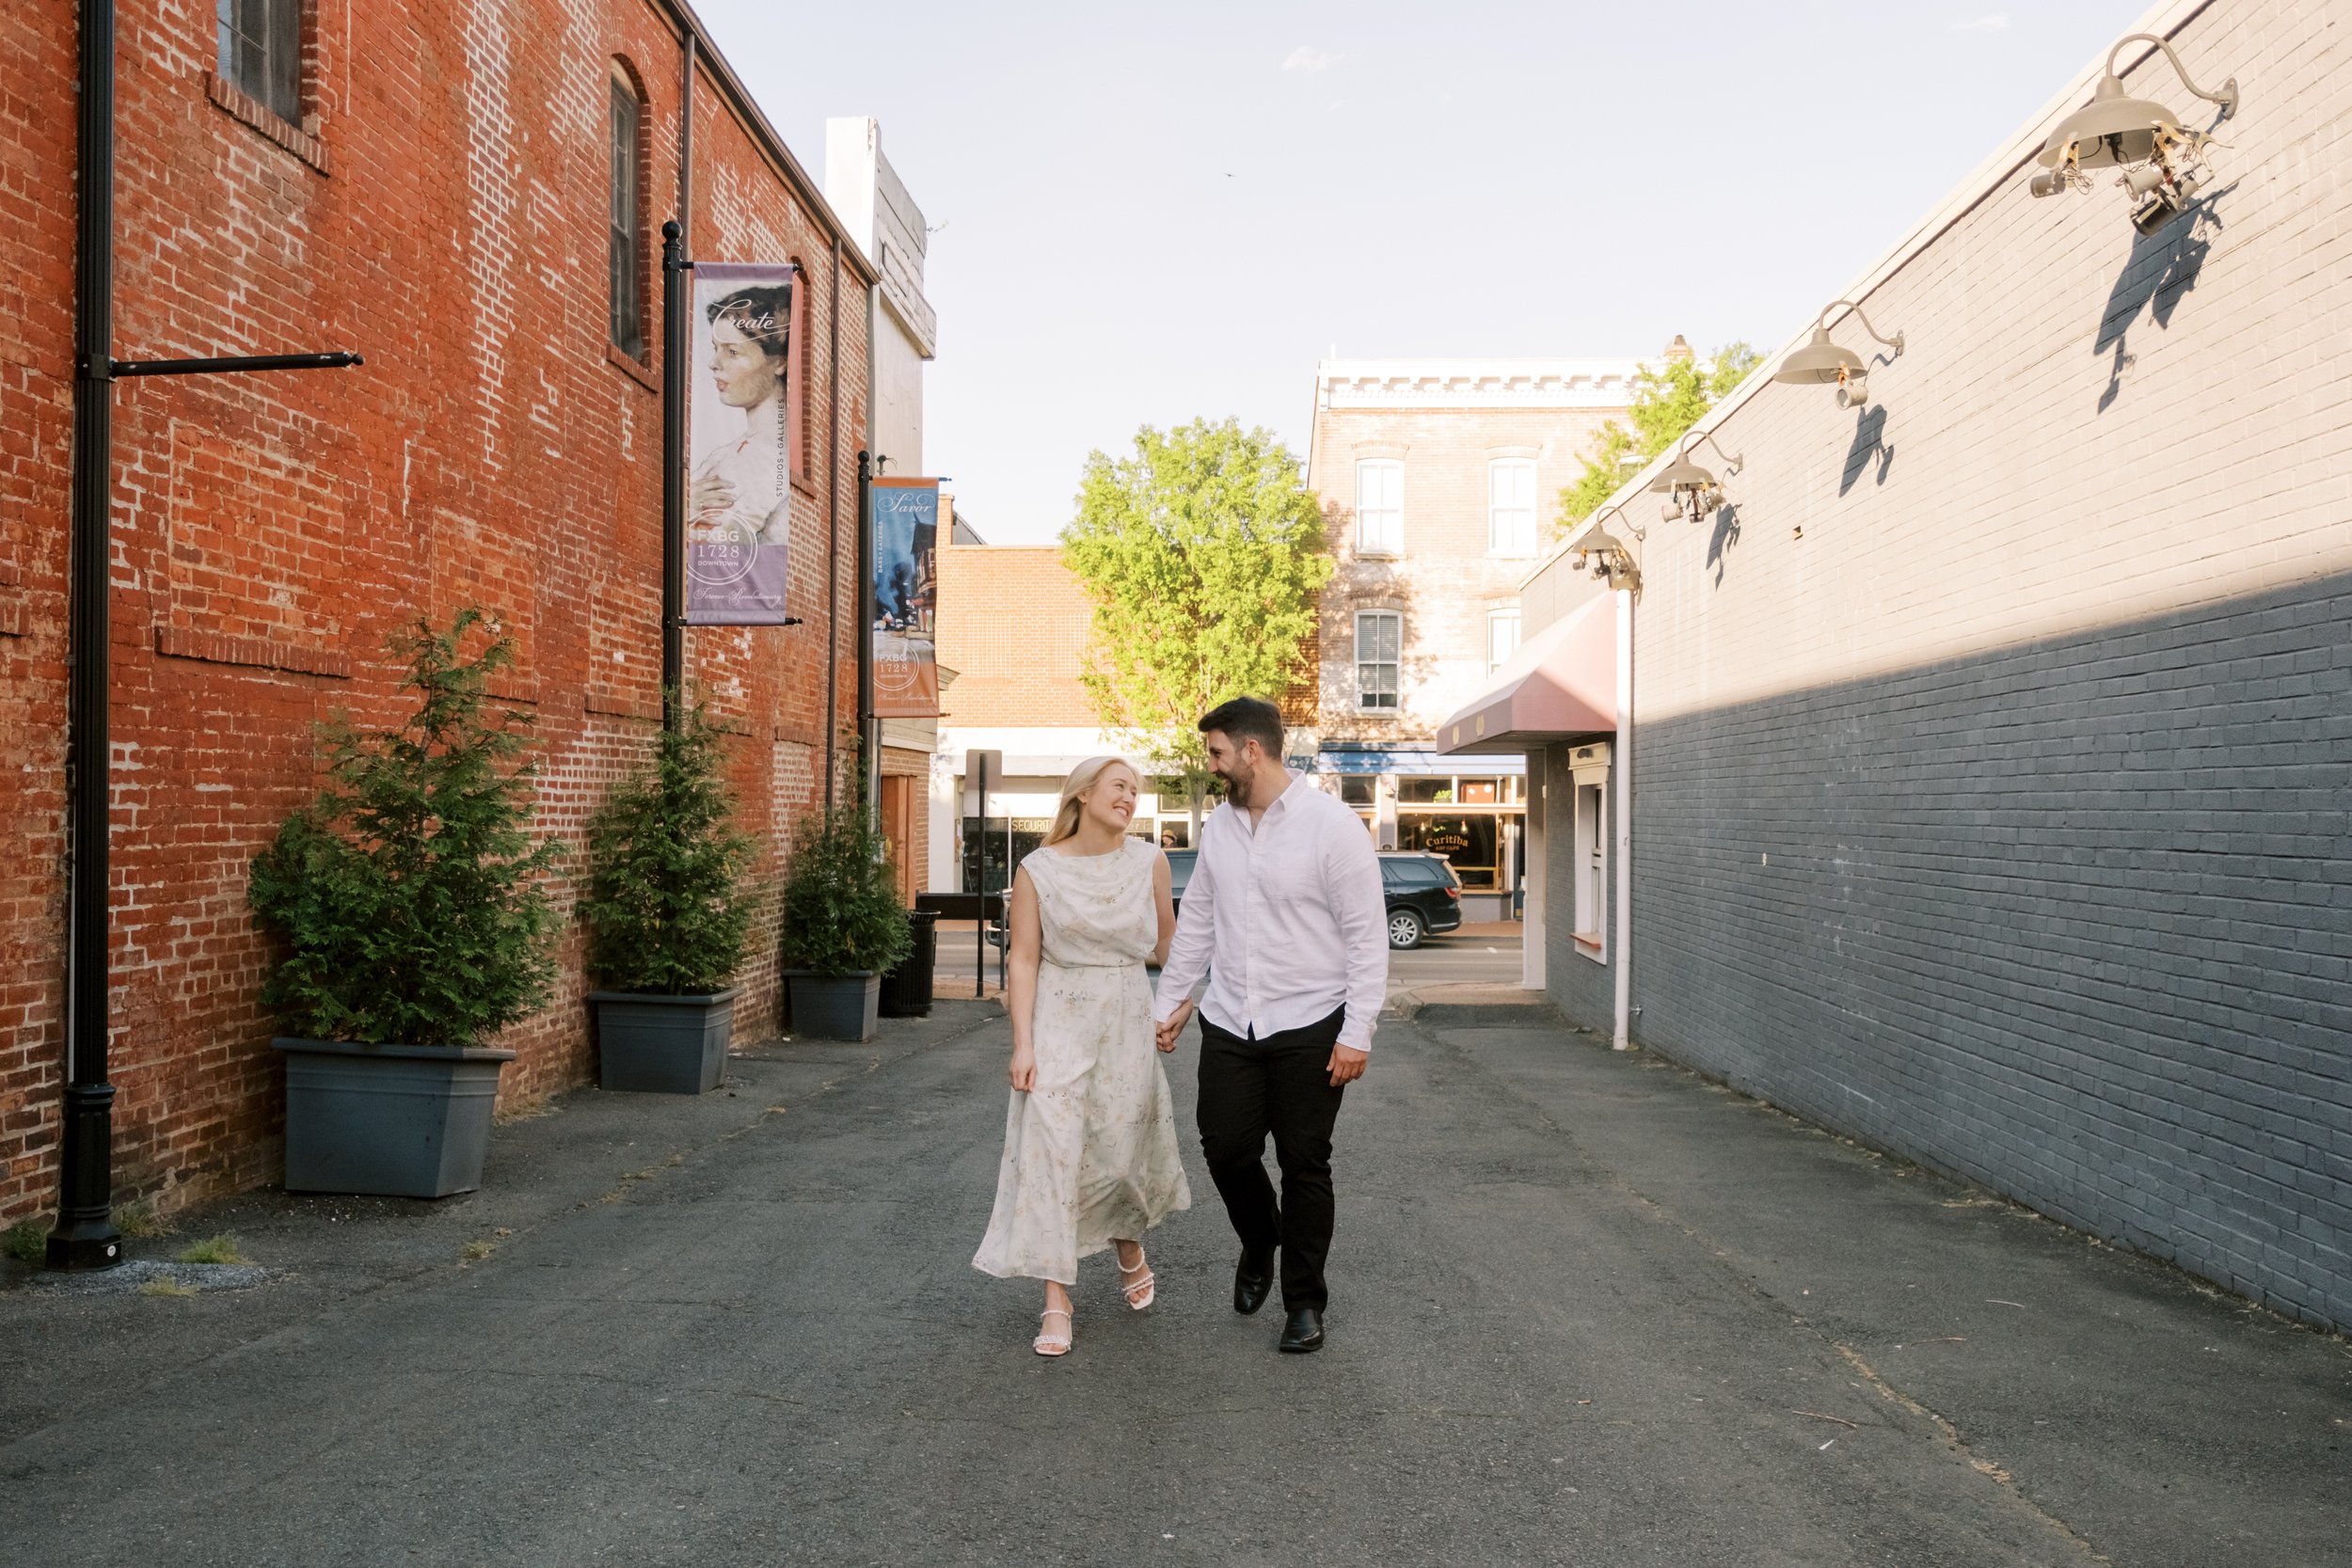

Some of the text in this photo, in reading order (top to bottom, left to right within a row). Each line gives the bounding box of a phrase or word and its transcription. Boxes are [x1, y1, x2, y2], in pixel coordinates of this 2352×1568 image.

[712, 298, 783, 343] Create
[877, 492, 935, 513] Savor
[697, 531, 739, 542] FXBG
[698, 546, 739, 558] 1728
[880, 654, 907, 662] FXBG
[881, 663, 908, 673] 1728
[1011, 819, 1051, 832] SECURIT
[1425, 835, 1469, 847] Curitiba
